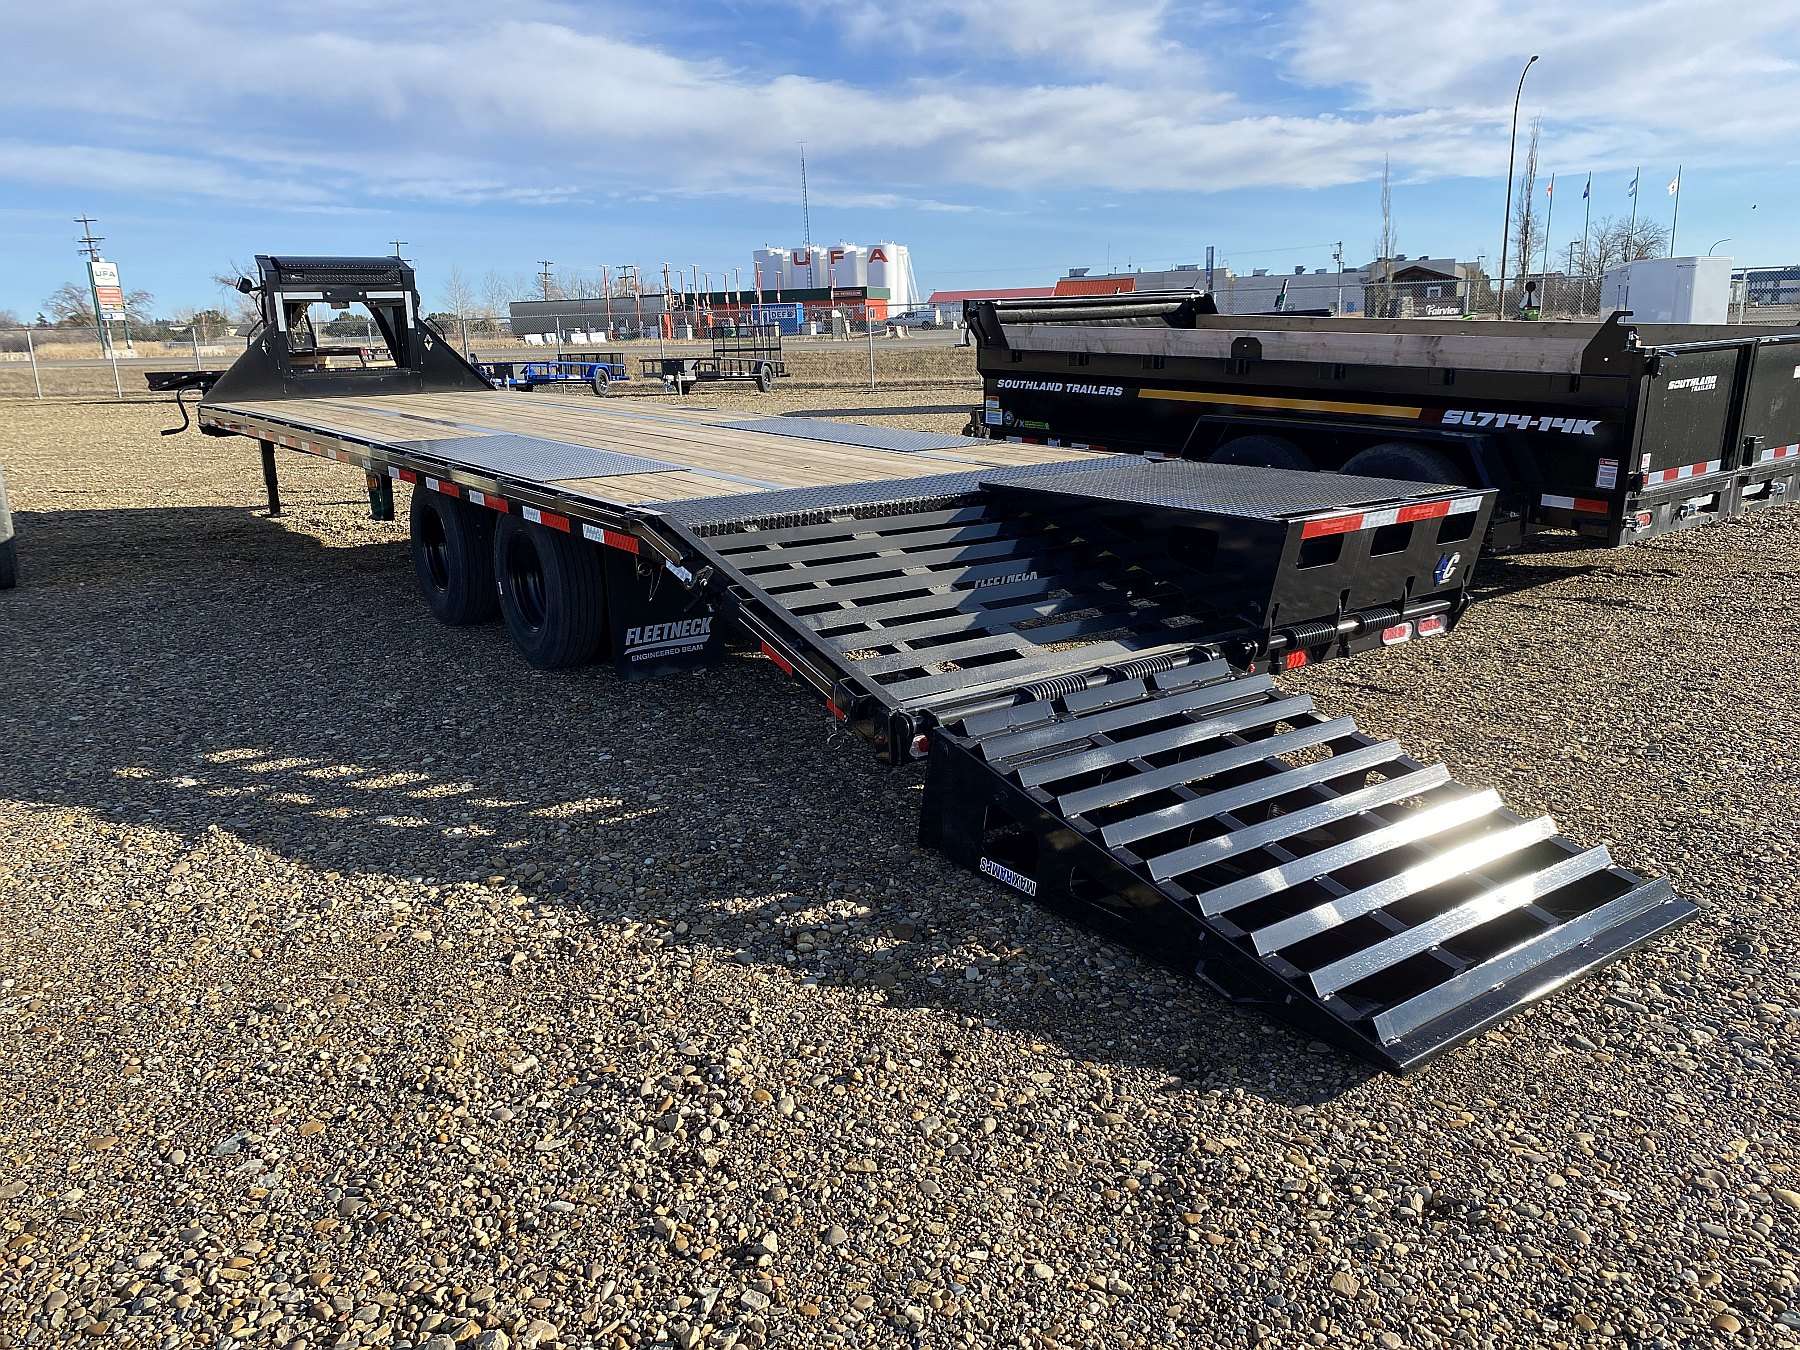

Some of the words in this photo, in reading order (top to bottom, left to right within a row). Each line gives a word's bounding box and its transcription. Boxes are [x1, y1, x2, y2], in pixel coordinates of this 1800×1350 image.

[793, 248, 889, 266] UFA
[1426, 304, 1462, 316] Fairview
[996, 379, 1063, 392] SOUTHLAND
[1066, 383, 1124, 396] TRAILERS
[1667, 375, 1718, 390] SOUTHLAND
[1441, 409, 1603, 436] SL714-14K
[625, 616, 713, 646] FLEETNECK
[631, 648, 681, 662] ENGINEERED
[681, 644, 704, 653] BEAM
